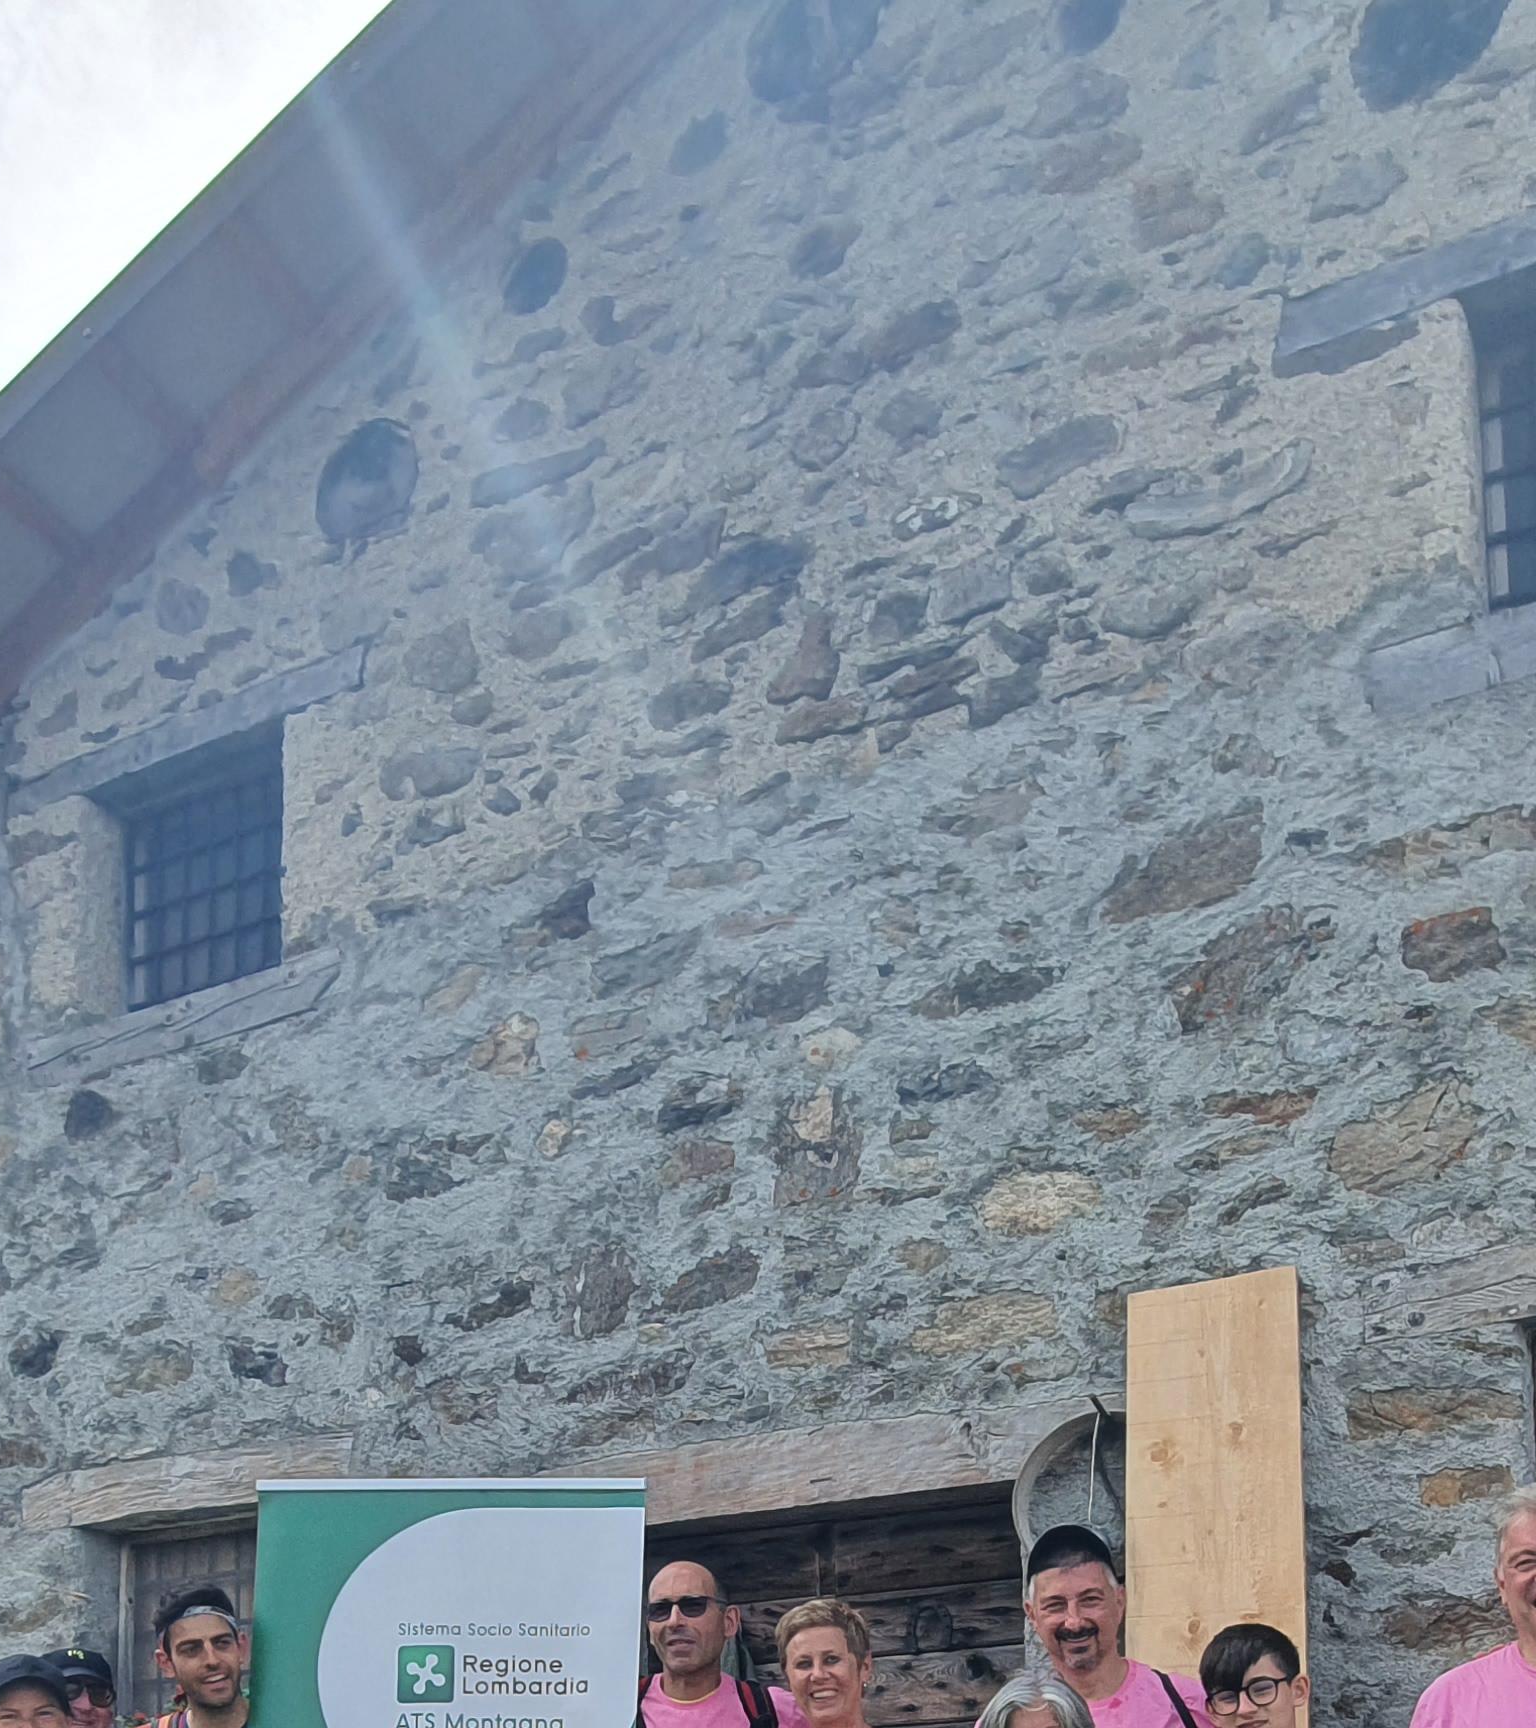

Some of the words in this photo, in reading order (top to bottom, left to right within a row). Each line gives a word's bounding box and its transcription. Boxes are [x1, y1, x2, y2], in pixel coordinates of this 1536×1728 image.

[398, 1622, 462, 1636] Sistema
[467, 1623, 513, 1637] Socio
[518, 1623, 591, 1637] Sanitario
[463, 1655, 564, 1678] Regione
[462, 1676, 589, 1695] Lombardia
